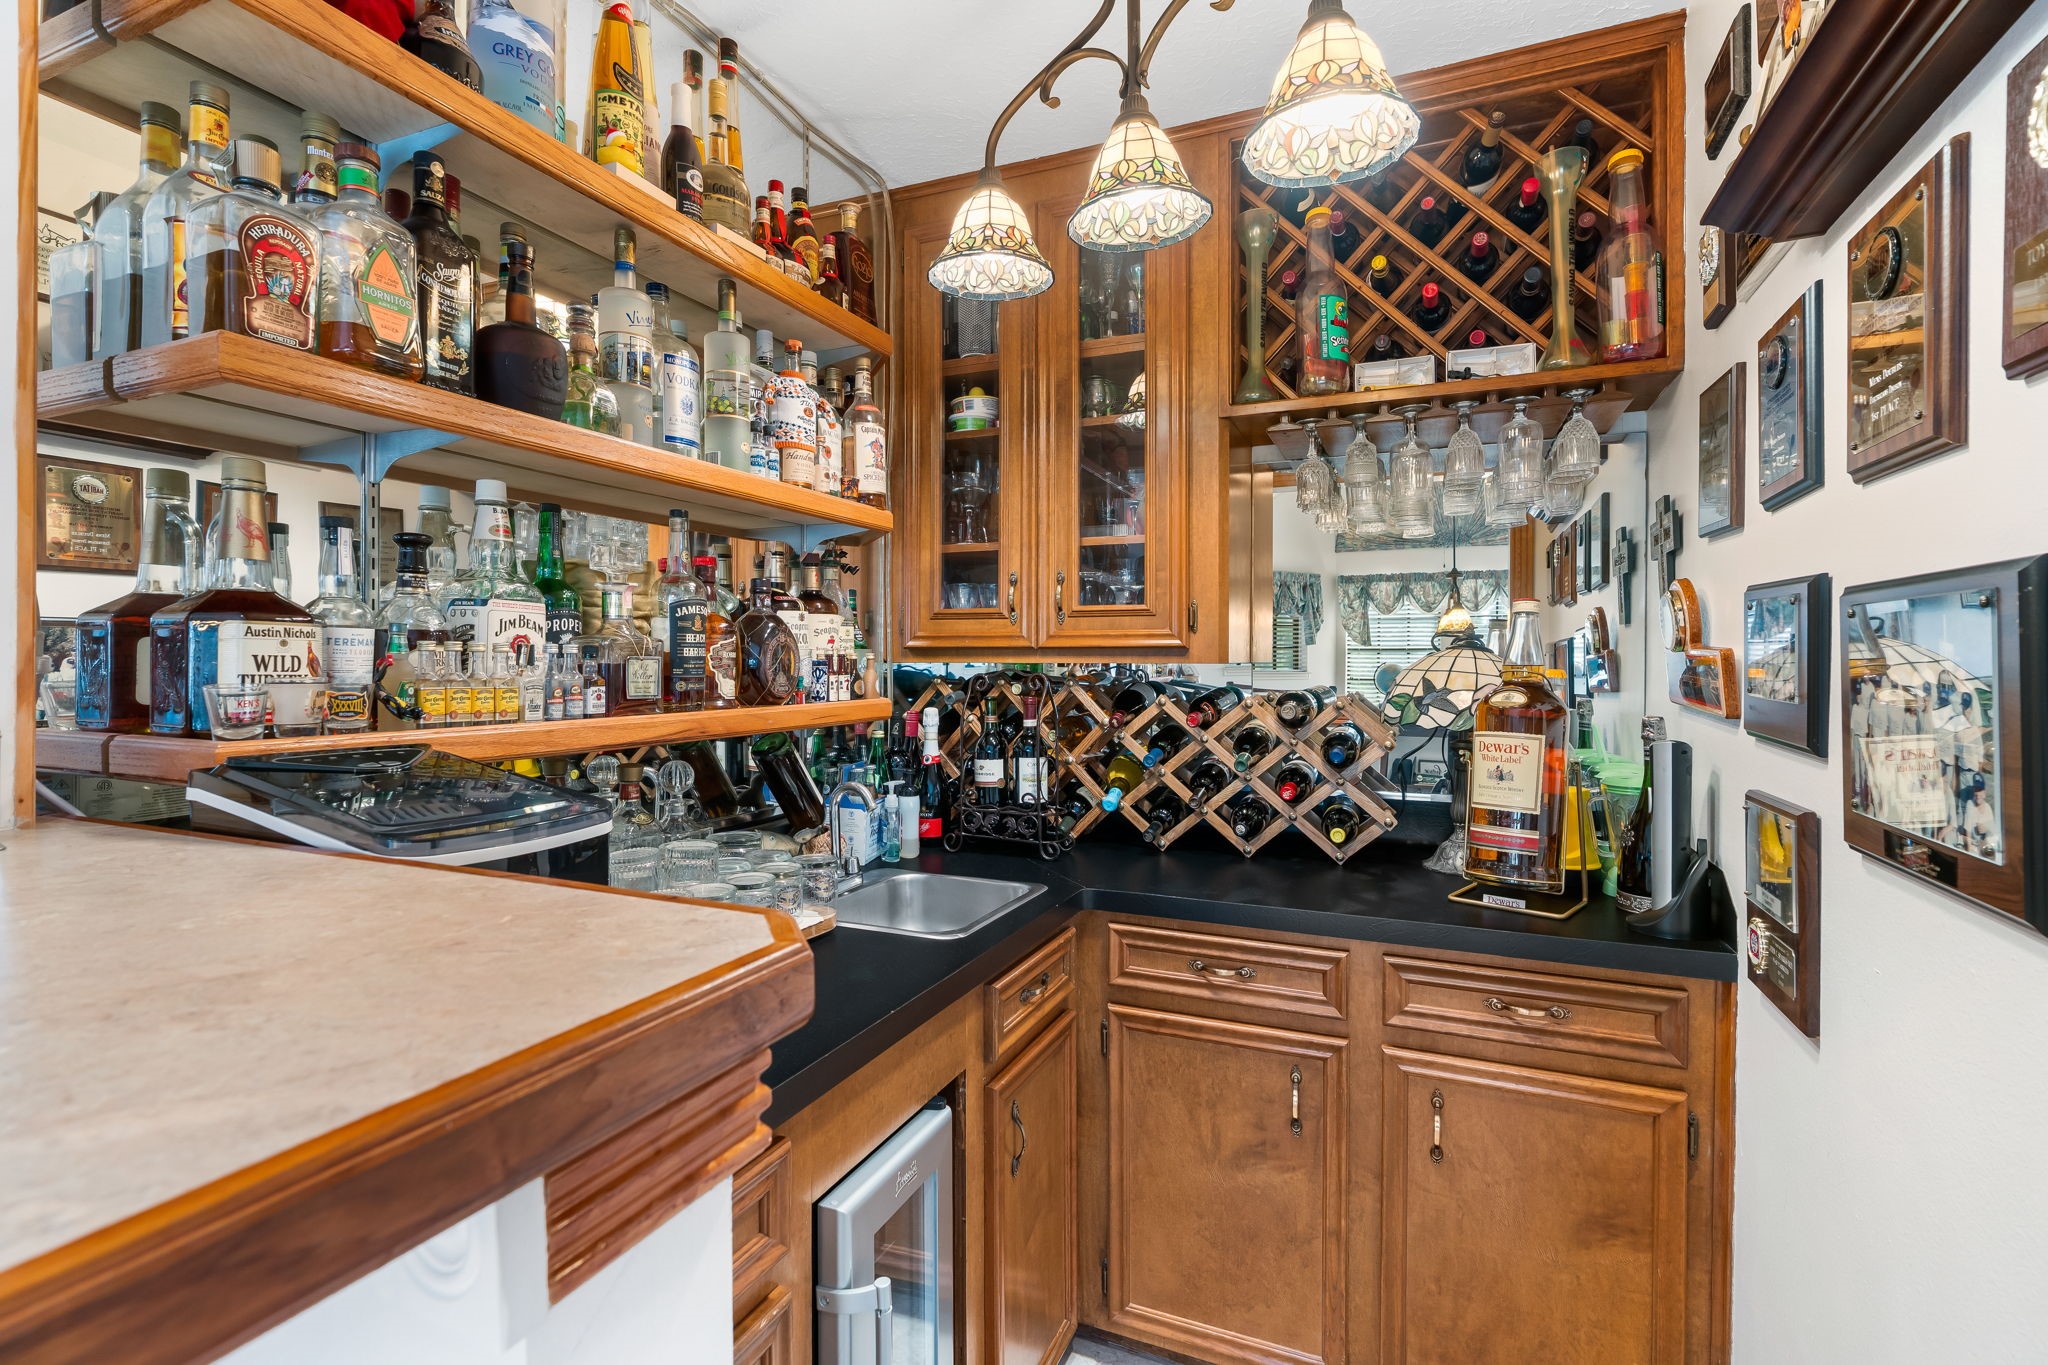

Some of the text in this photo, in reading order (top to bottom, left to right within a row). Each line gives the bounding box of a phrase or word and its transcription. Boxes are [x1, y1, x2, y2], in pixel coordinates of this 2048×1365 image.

[492, 42, 535, 64] GREY
[607, 94, 644, 115] META
[307, 145, 334, 160] Montez
[420, 189, 445, 204] SAUZA
[248, 223, 311, 258] HERRADURA
[254, 248, 265, 283] TEQUILA
[1568, 208, 1576, 305] SAVING THE WORLD
[294, 261, 305, 296] NATURAL
[362, 284, 412, 310] HORNITOS
[261, 331, 296, 346] IMPORTED
[244, 625, 316, 639] Austin Nichols
[495, 614, 544, 638] JIM BEAM
[252, 654, 302, 673] WILD
[1478, 741, 1530, 755] Dewar's
[1481, 753, 1521, 764] White Label
[1487, 895, 1521, 909] Dewar's
